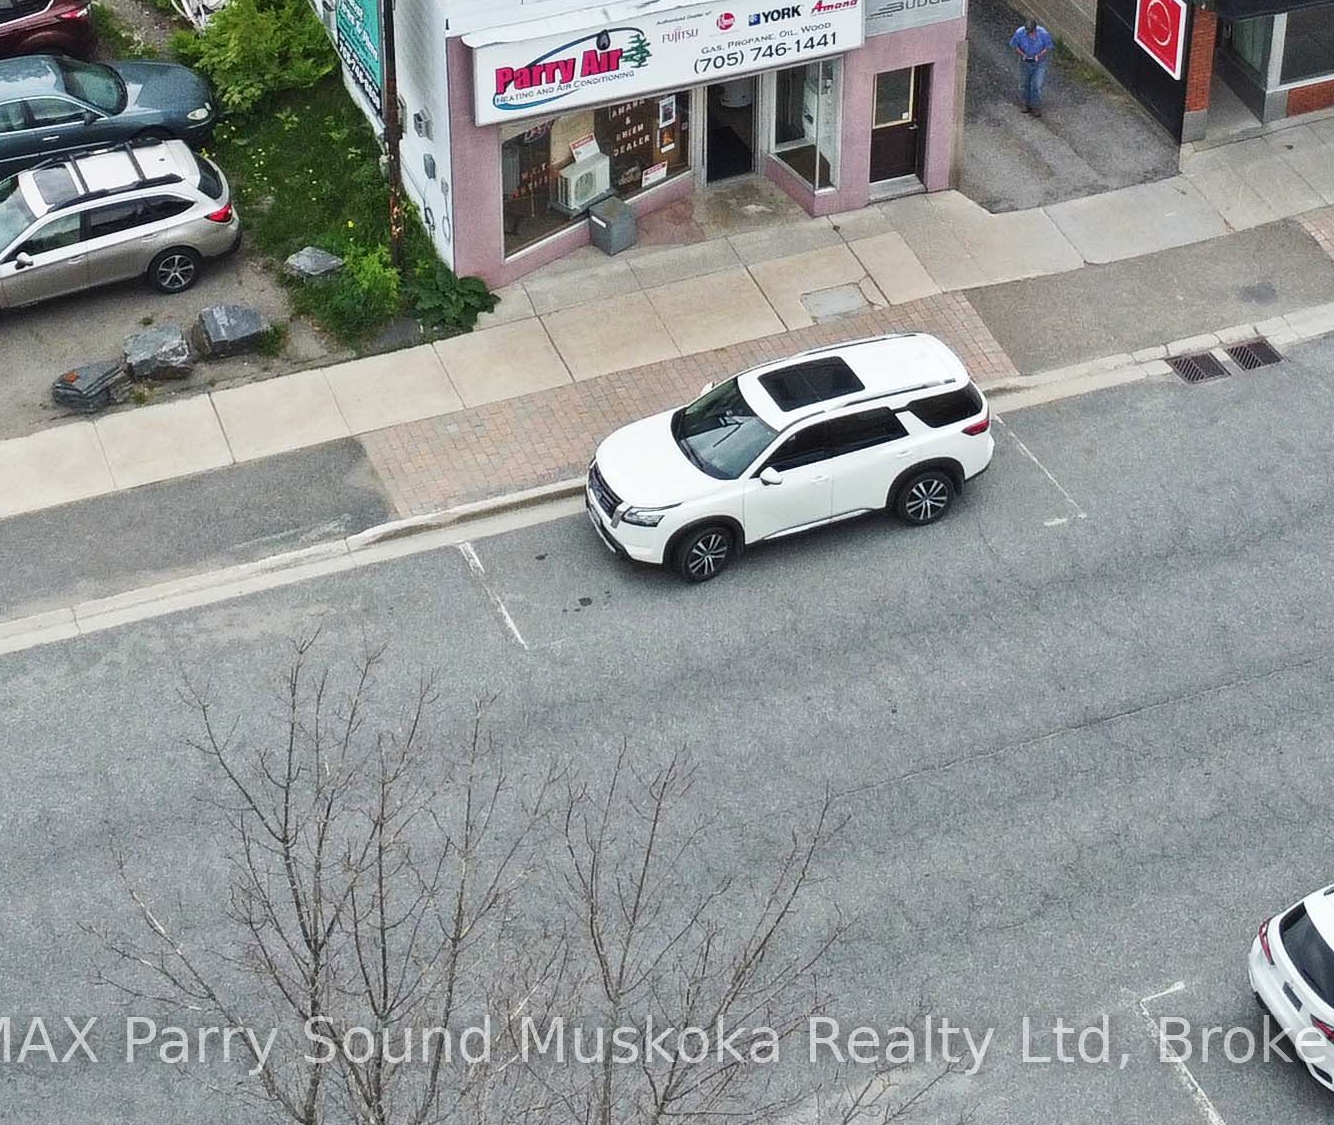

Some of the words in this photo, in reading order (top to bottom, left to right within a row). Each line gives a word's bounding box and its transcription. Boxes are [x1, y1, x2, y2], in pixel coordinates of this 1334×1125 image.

[761, 4, 802, 24] YORK
[811, 0, 859, 14] Amana
[661, 27, 698, 43] FUJITSU
[693, 52, 745, 75] (705)
[750, 32, 838, 62] 746-1441
[495, 58, 576, 95] Parry
[580, 48, 624, 78] Air
[613, 133, 651, 157] DEALER
